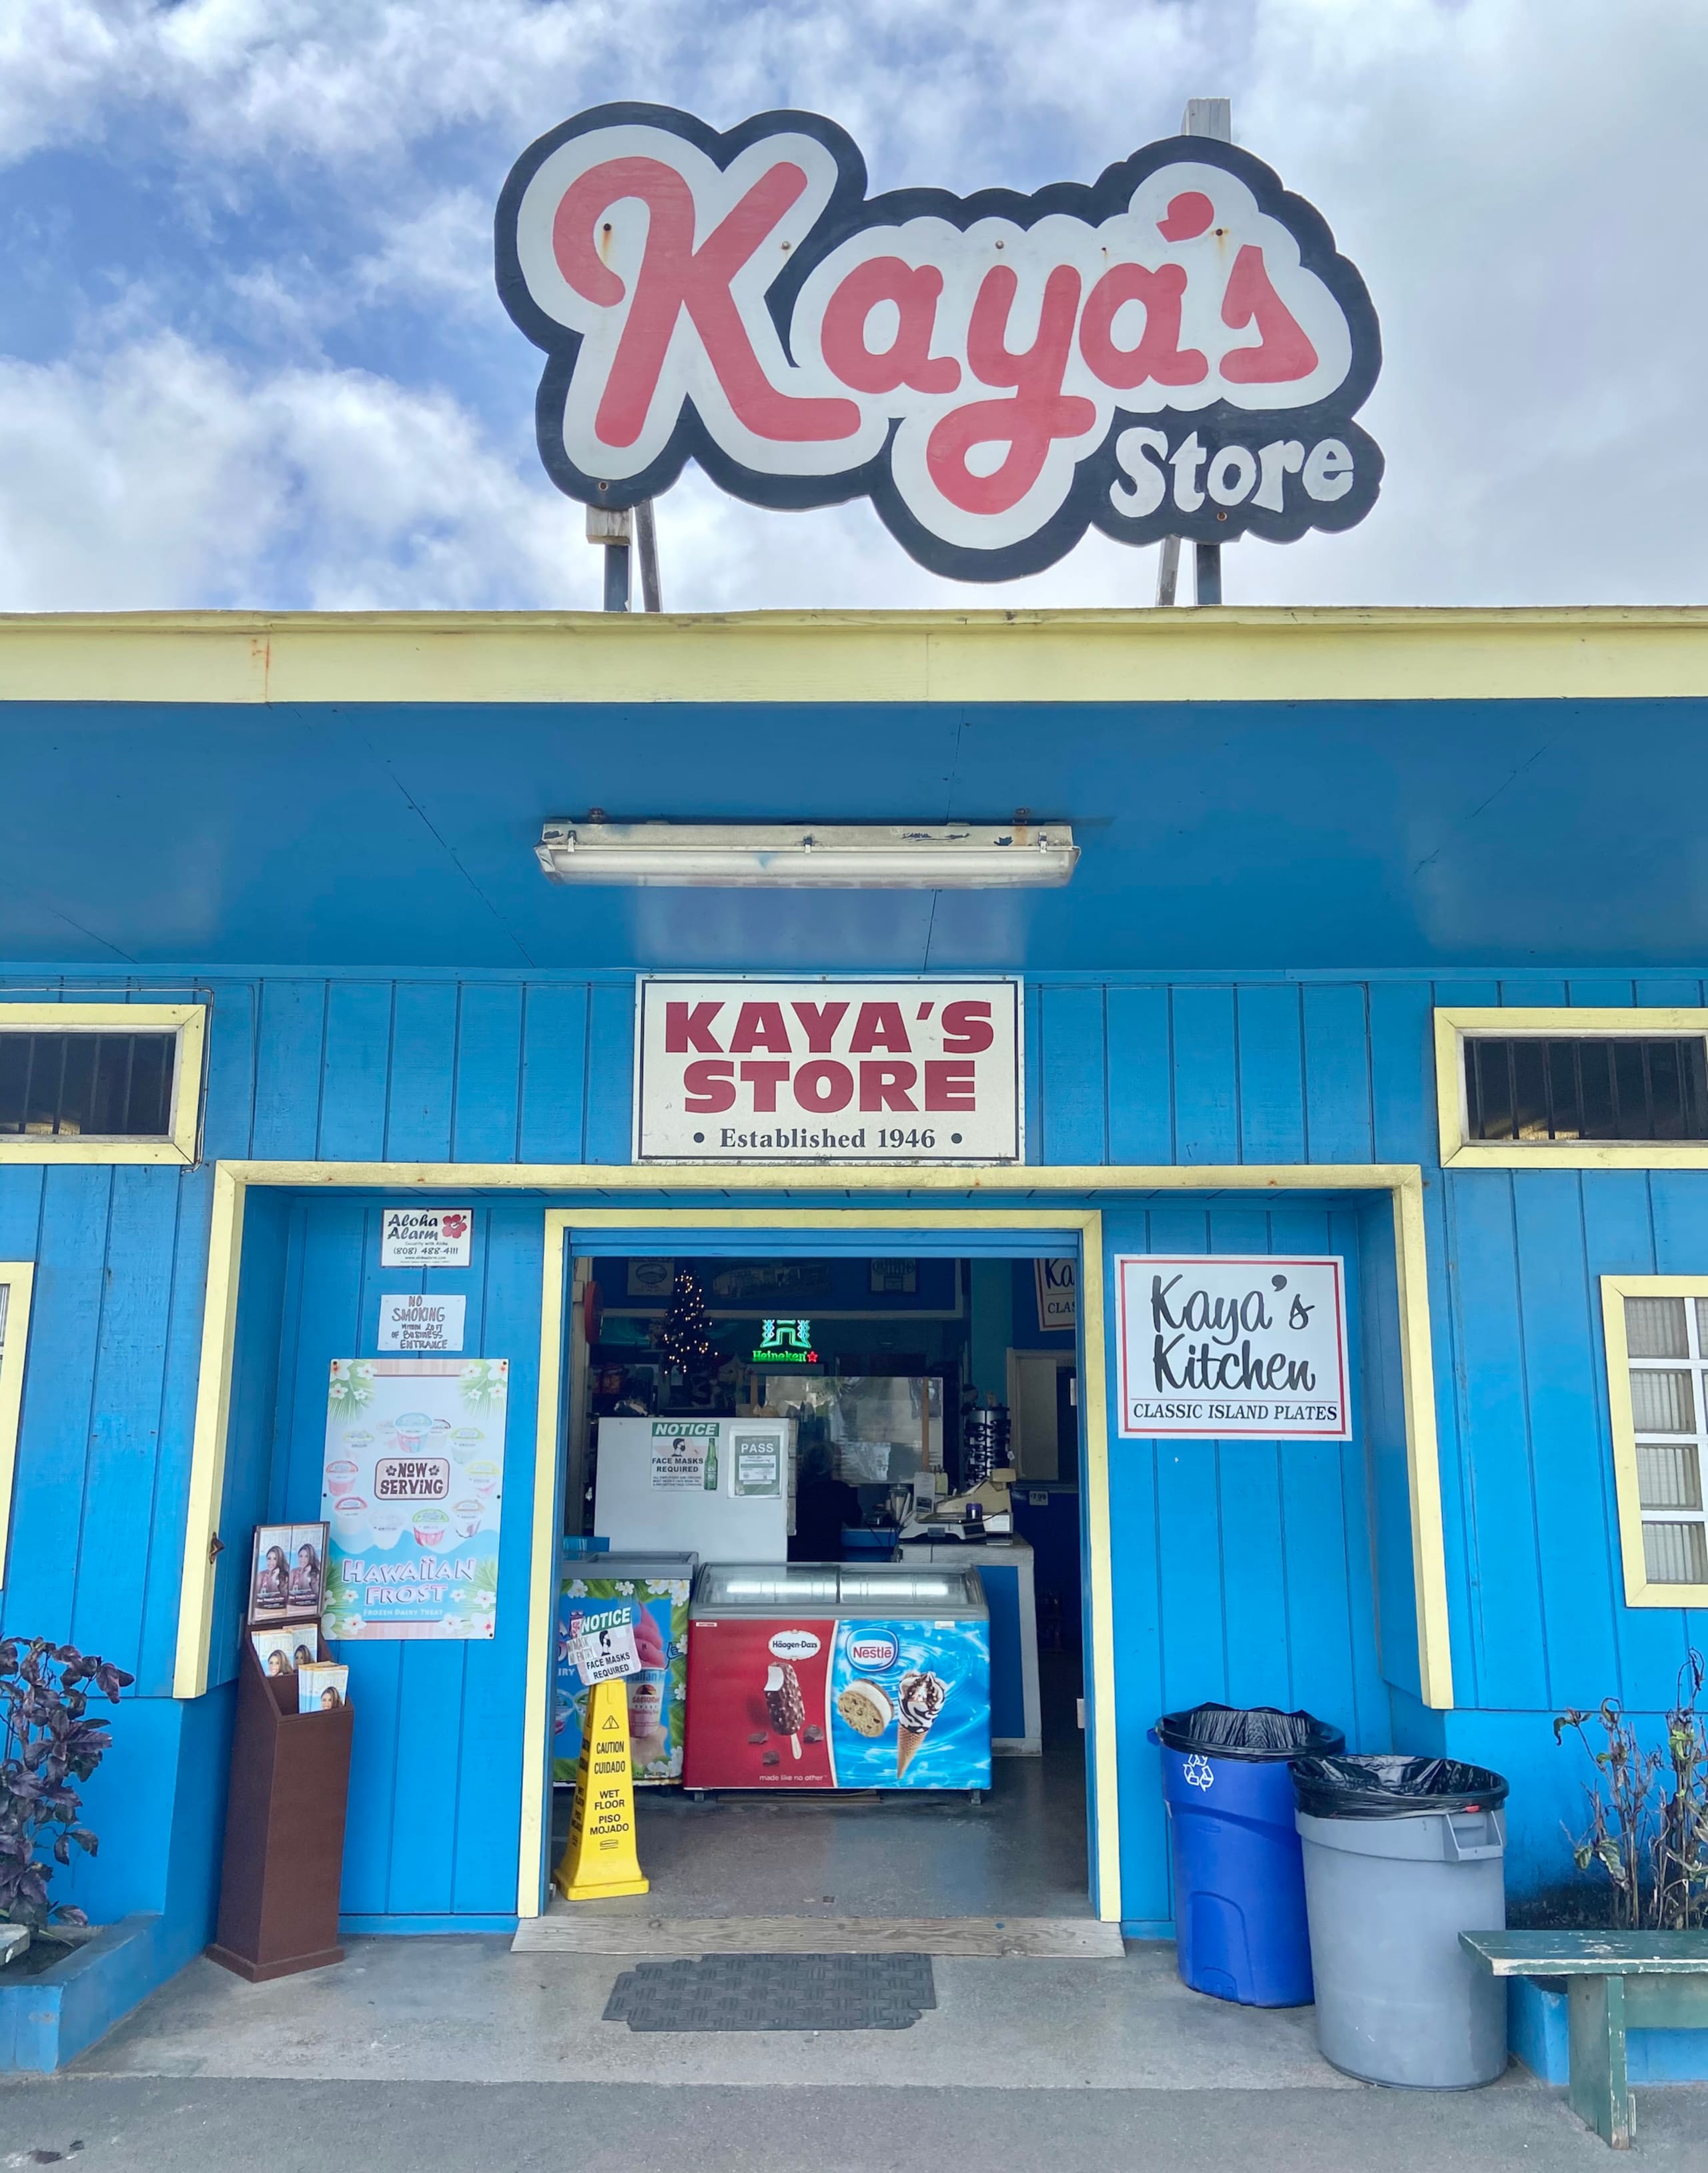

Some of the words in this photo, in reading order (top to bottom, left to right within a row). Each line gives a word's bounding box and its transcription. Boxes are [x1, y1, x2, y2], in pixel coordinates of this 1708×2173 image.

[552, 156, 1319, 514] Kaya's
[1110, 426, 1353, 518] Store
[666, 1001, 994, 1053] KAYA'S
[683, 1059, 975, 1114] STORE
[720, 1128, 865, 1148] Established
[878, 1128, 935, 1148] 1946
[388, 1214, 438, 1226] Aloha
[387, 1227, 438, 1240] Alarm
[394, 1247, 417, 1255] (808)
[421, 1247, 458, 1255] 488-4111
[408, 1296, 422, 1307] NO
[392, 1307, 446, 1322] SMOKING
[1151, 1274, 1315, 1345] Kaya's
[392, 1331, 400, 1339] OF
[403, 1330, 443, 1339] BUSINESS
[400, 1340, 448, 1349] ENTRANCE
[752, 1350, 807, 1362] Heineken
[1153, 1334, 1316, 1392] Kitchen
[1134, 1403, 1203, 1419] CLASSIC
[1208, 1404, 1268, 1420] ISLAND
[1274, 1406, 1338, 1421] PLATES
[655, 1424, 717, 1435] NOTICE
[741, 1443, 774, 1453] PASS
[398, 1462, 428, 1478] NOW
[364, 1583, 448, 1607] FROST
[581, 1607, 631, 1634] NOTICE
[586, 1658, 604, 1670] FACE
[606, 1652, 630, 1665] MASKS
[558, 1668, 574, 1676] IRY
[593, 1664, 629, 1679] REQUIRED
[596, 1740, 624, 1754] CAUTION
[594, 1761, 625, 1774] CUIDADO
[600, 1789, 619, 1799] WET
[594, 1799, 624, 1810] FLOOR
[598, 1813, 620, 1823] PISO
[590, 1823, 629, 1835] MOJADO
